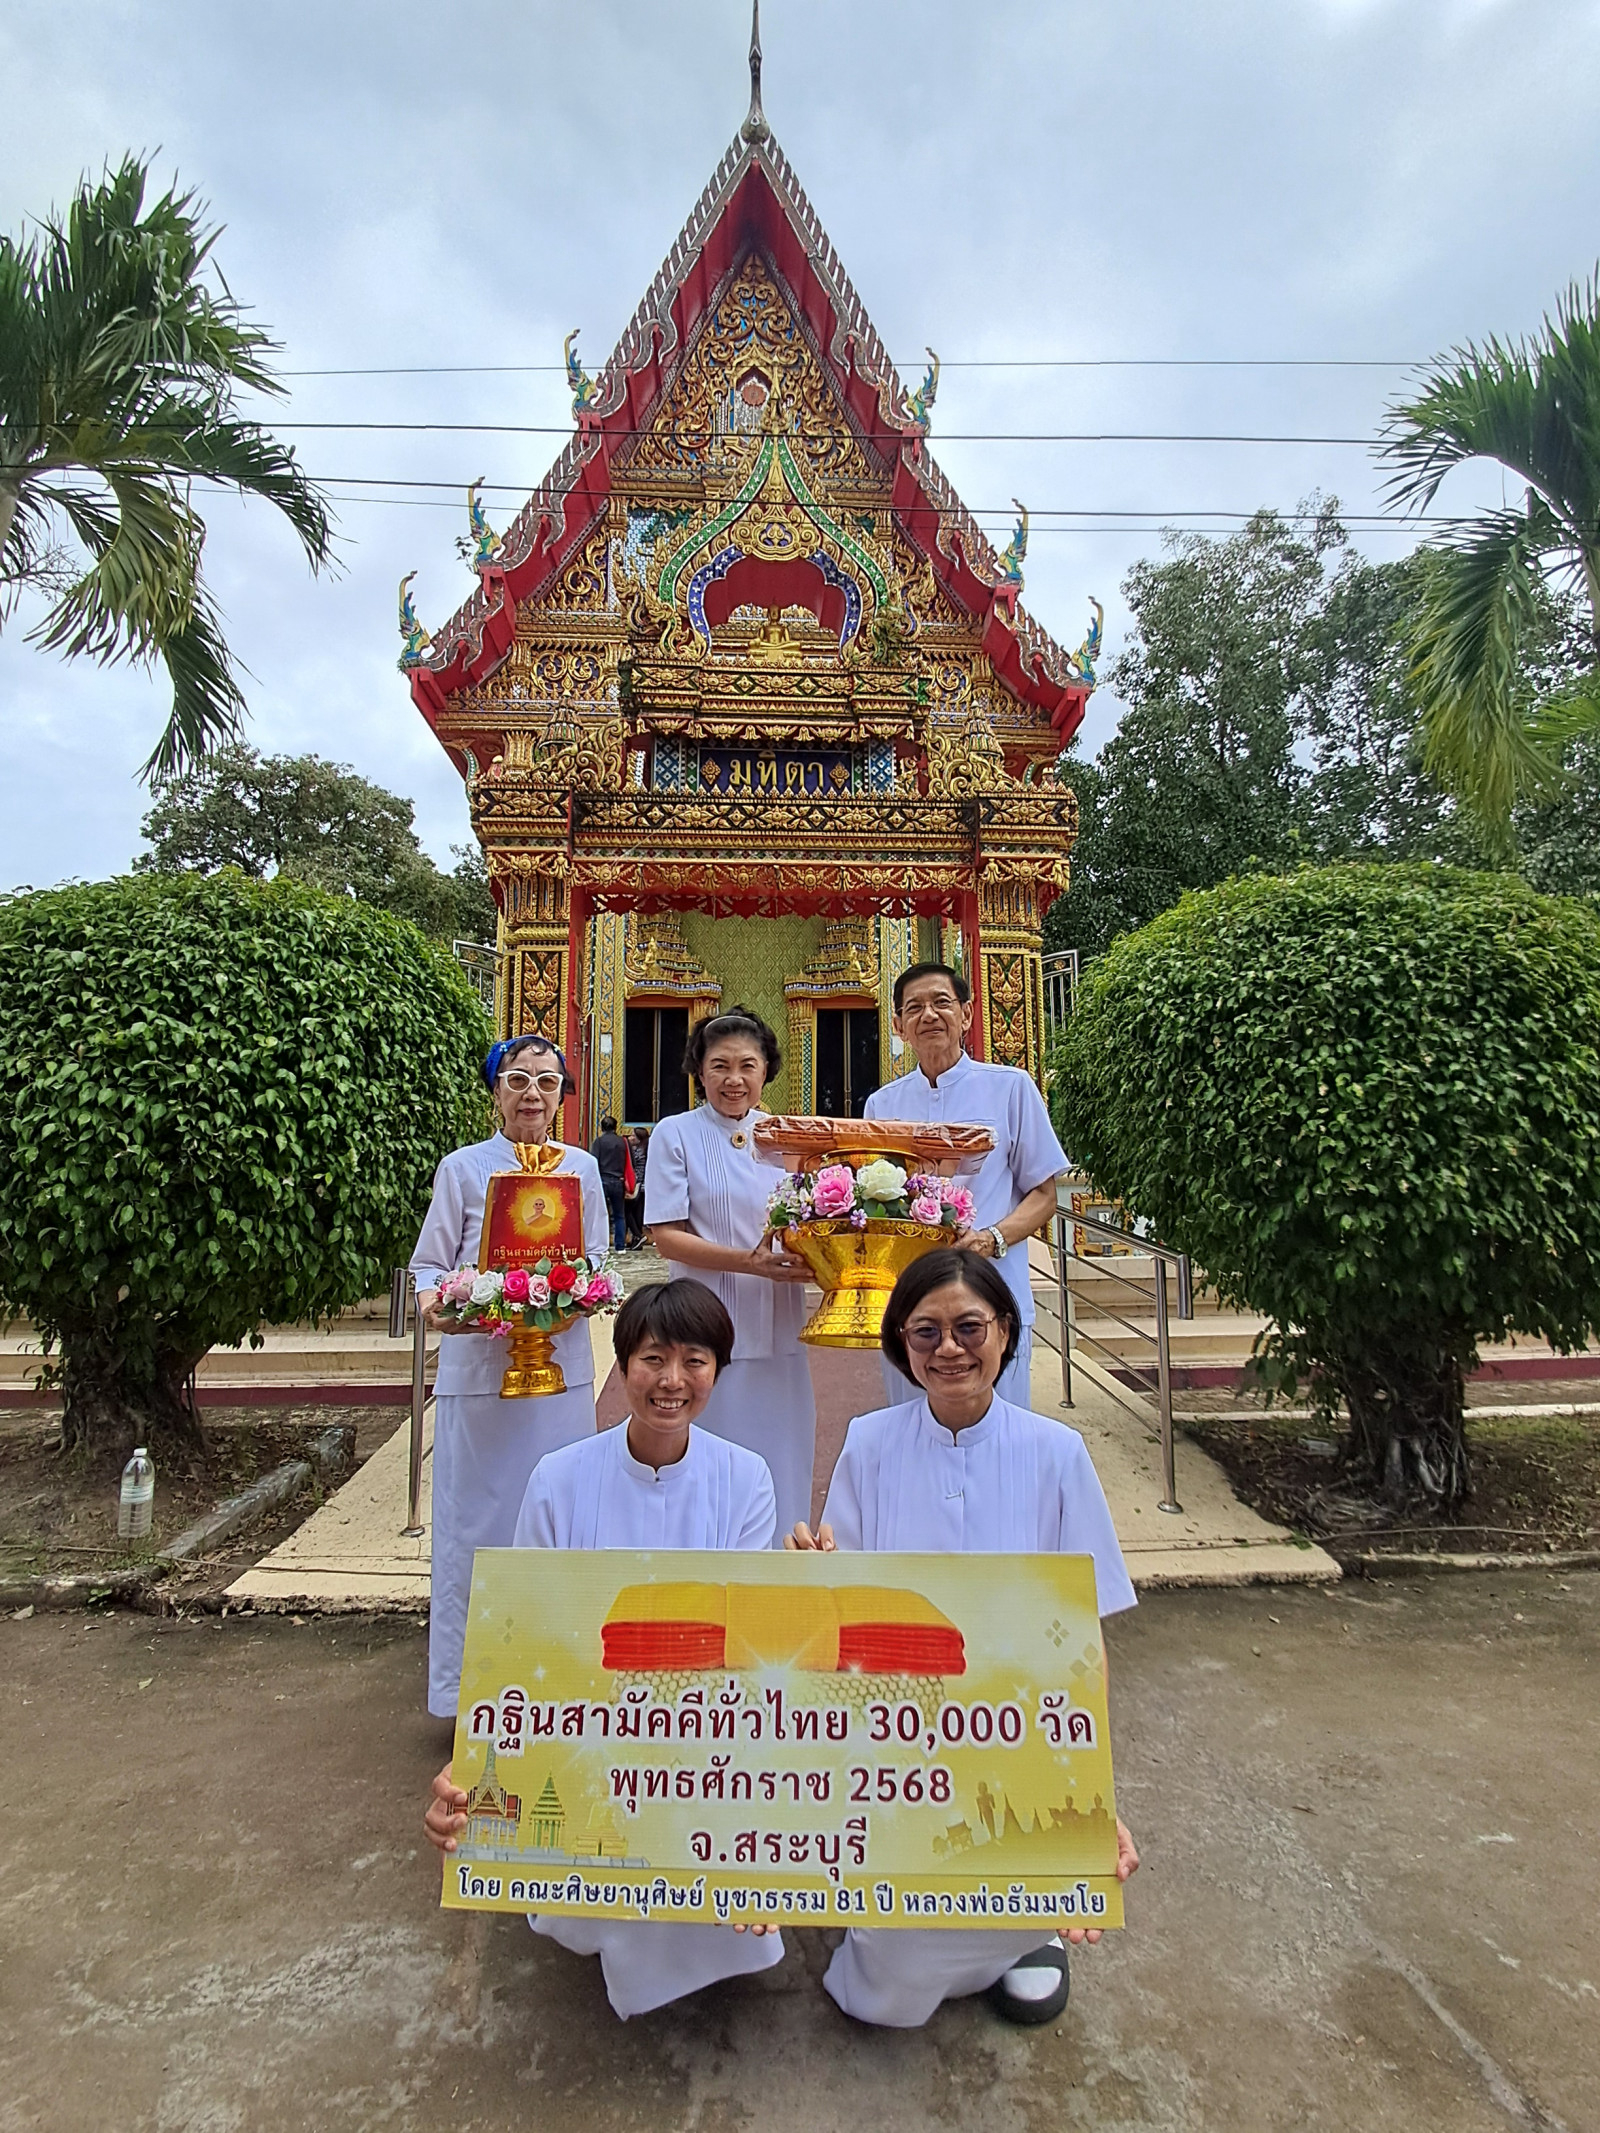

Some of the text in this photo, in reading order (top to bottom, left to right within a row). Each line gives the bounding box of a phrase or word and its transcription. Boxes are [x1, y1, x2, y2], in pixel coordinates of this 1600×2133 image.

[471, 1679, 1093, 1751] กฐินสามัคคีทั่วไทย 30,000 วัด
[610, 1755, 951, 1814] พุทธศักราช 2568
[689, 1816, 867, 1882] จ.สระบุรี
[458, 1866, 1106, 1918] โดย คณะศิษยานุศิษย์ บูชาธรรม 81 ปี หลวงพ่อธัมมชโย
